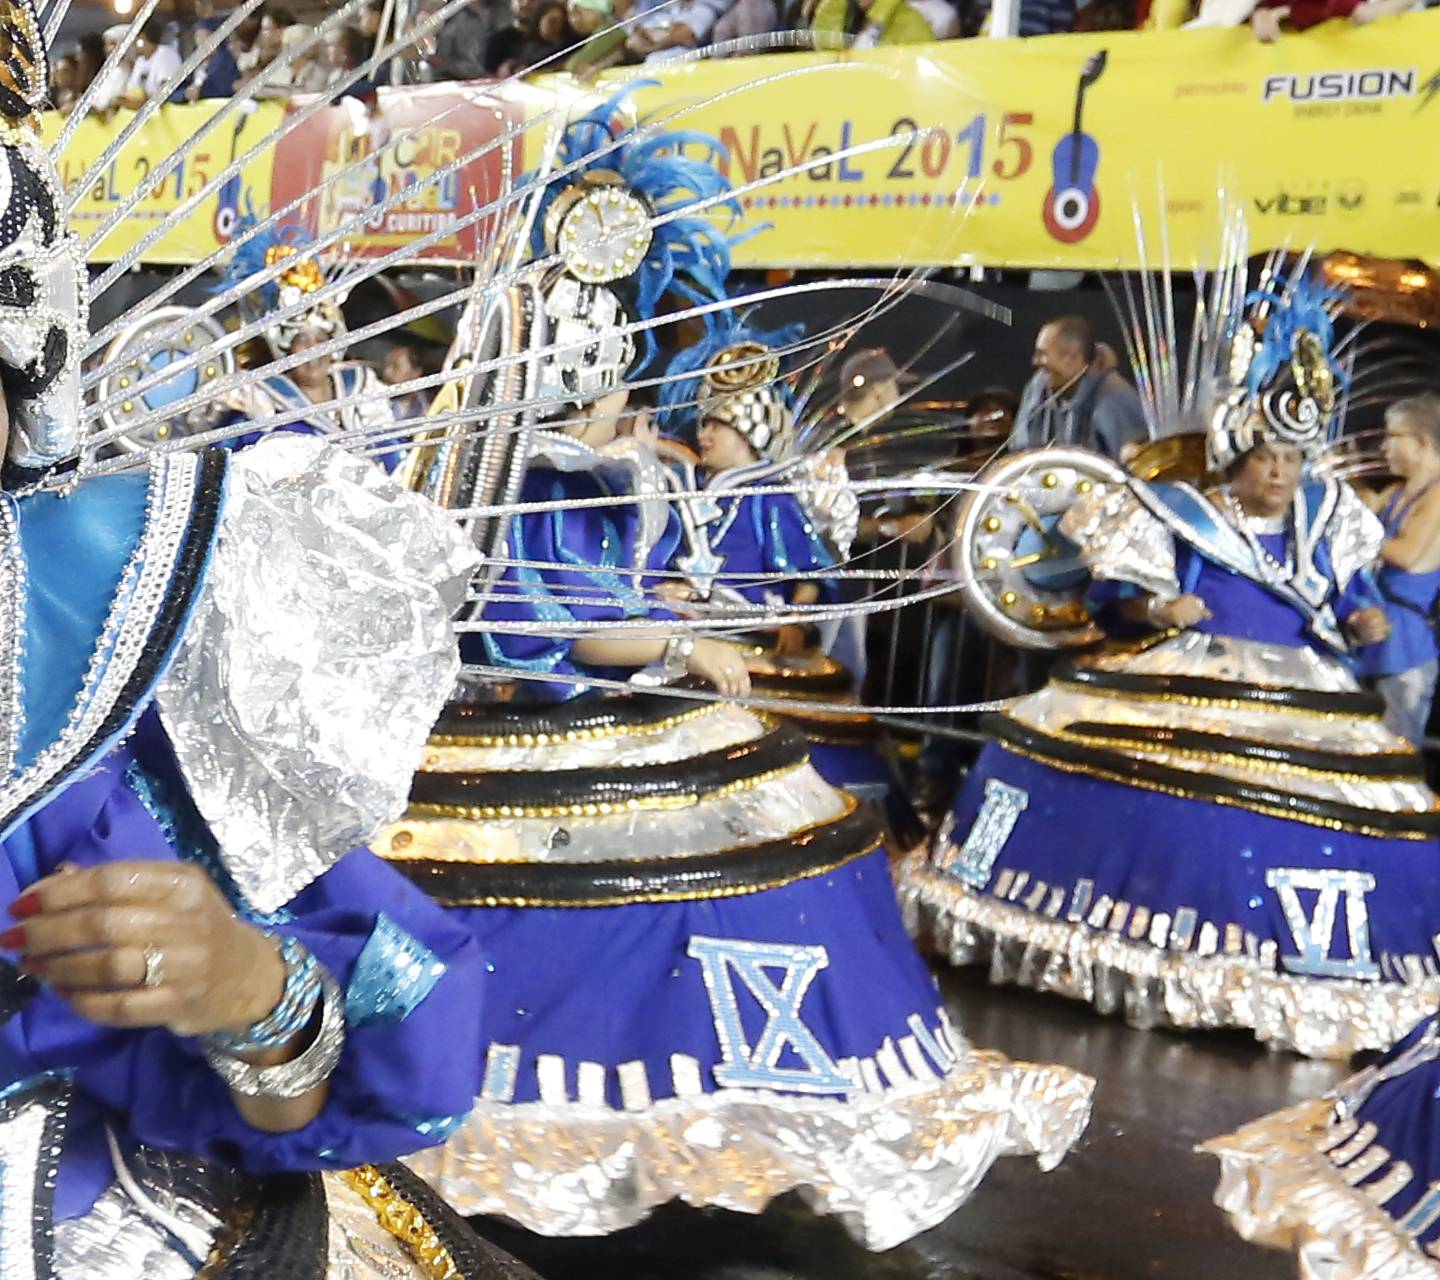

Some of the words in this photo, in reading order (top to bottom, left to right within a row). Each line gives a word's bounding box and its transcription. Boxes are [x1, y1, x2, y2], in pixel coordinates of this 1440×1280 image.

[1261, 68, 1417, 102] FUSION
[886, 112, 1036, 182] 2015
[1265, 867, 1380, 980] VI
[686, 935, 853, 1093] IX
